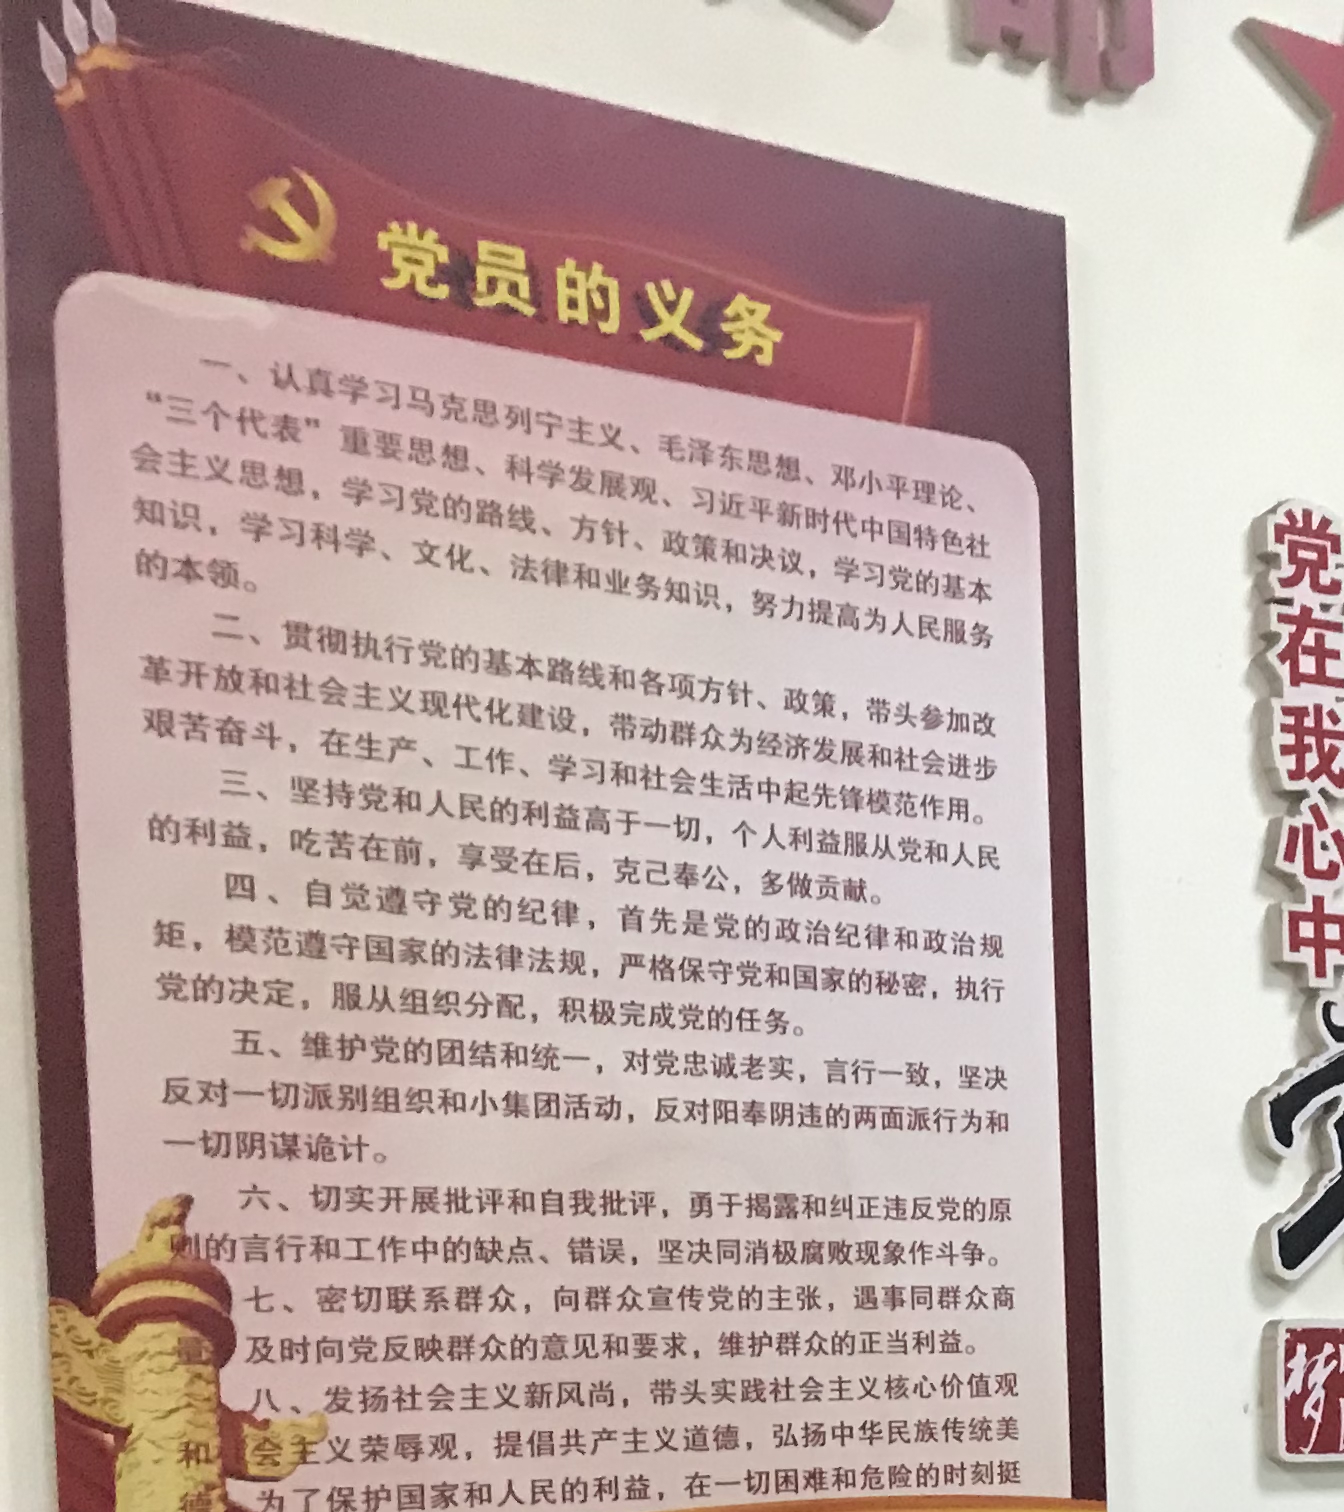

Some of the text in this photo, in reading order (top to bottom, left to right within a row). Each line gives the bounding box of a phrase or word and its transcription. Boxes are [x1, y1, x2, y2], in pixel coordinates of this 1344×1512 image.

[377, 221, 784, 367] 党员的义务
[135, 548, 257, 594] 的本领。
[163, 1130, 387, 1165] 一切阴谋诡计。
